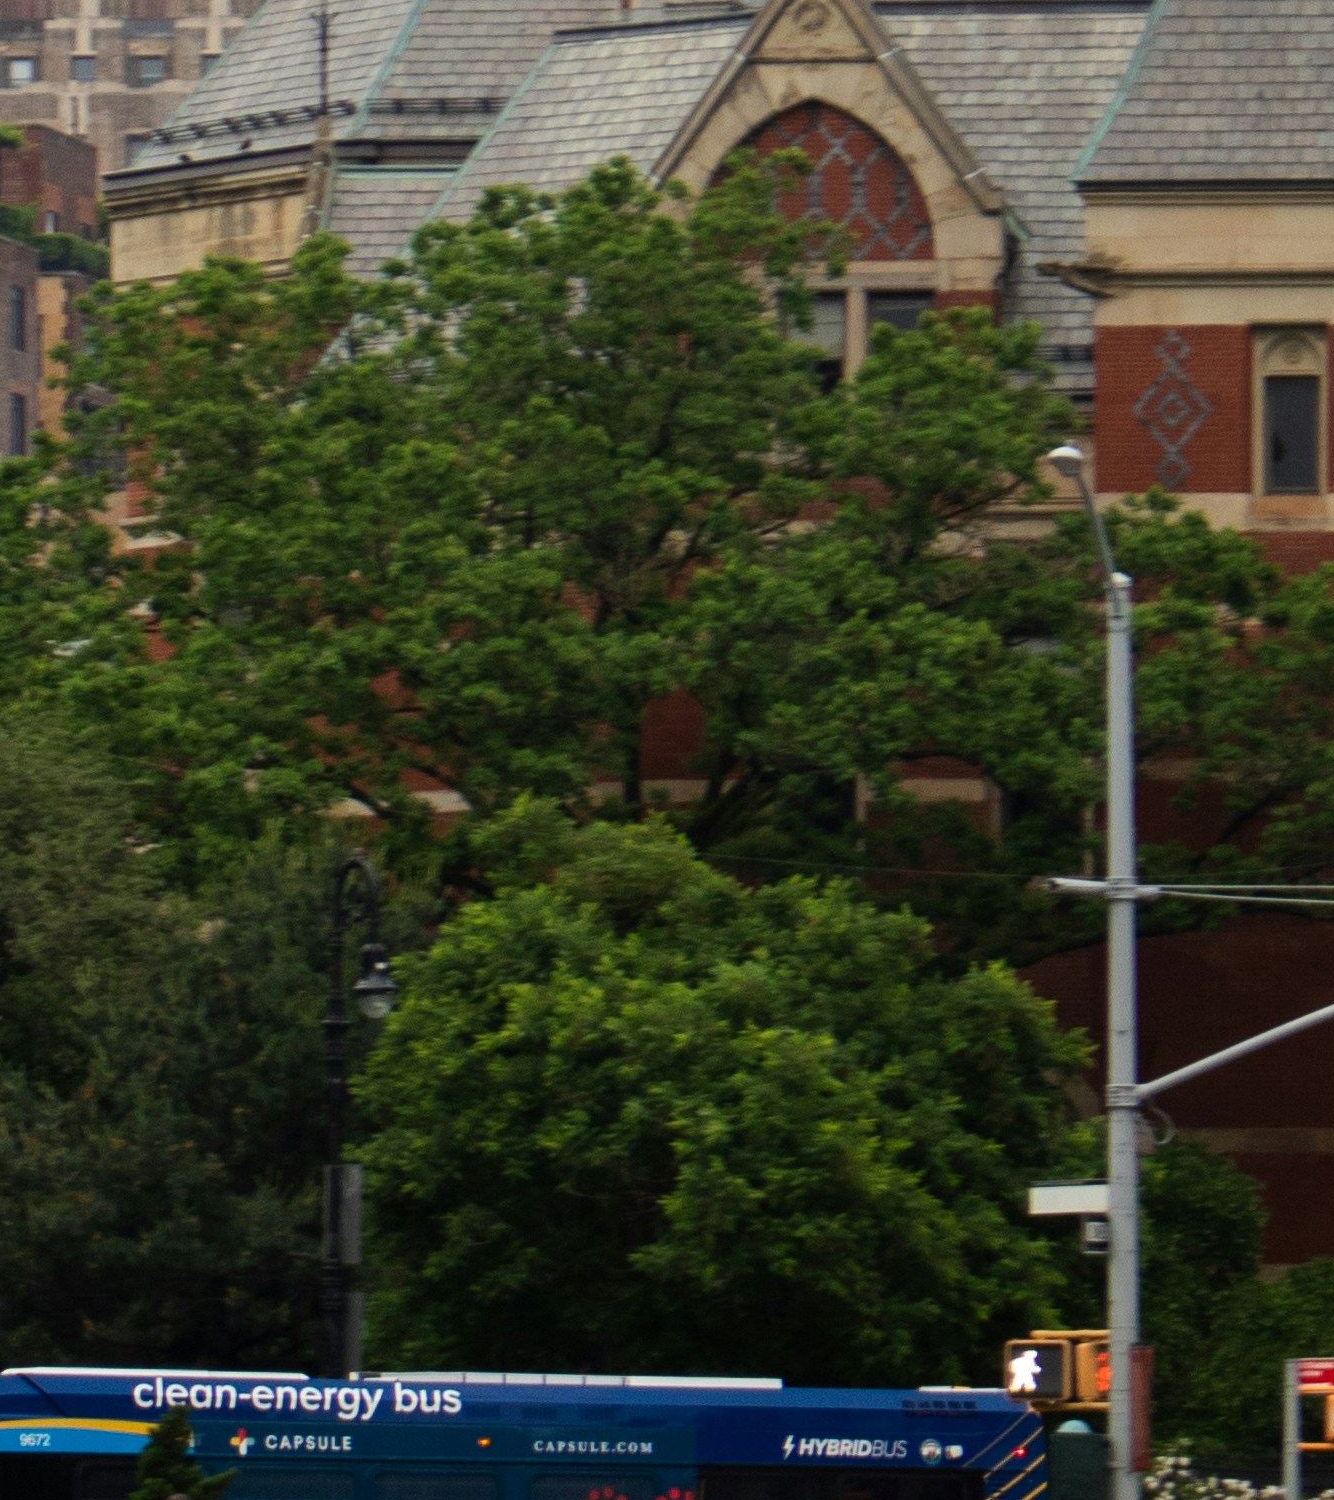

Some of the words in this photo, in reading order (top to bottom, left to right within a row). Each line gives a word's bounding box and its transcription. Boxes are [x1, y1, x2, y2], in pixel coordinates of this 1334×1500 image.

[133, 1377, 384, 1421] clean-energy
[393, 1381, 463, 1414] bus
[19, 1433, 51, 1448] 9672
[264, 1434, 353, 1451] CAPSULE
[532, 1438, 654, 1455] CAPSULE.COM
